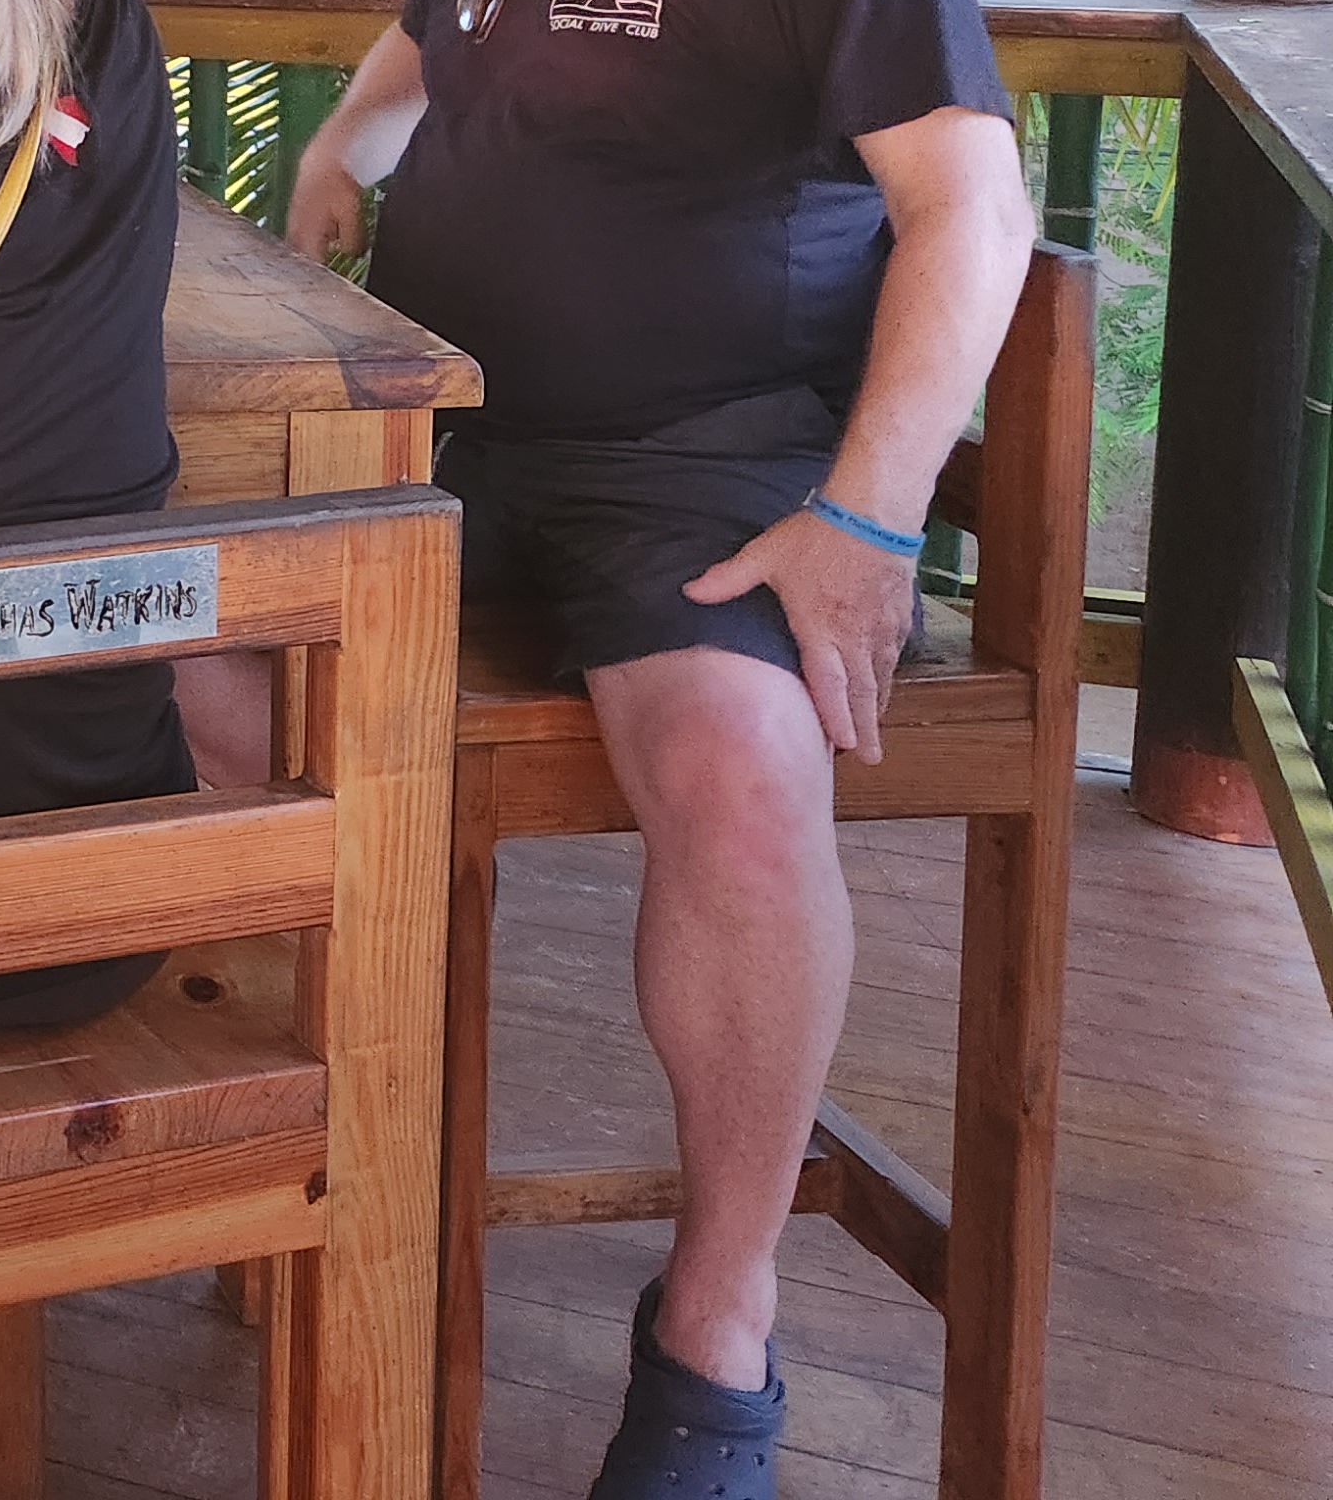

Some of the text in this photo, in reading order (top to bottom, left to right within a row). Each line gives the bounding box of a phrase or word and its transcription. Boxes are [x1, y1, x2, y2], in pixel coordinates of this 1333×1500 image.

[550, 19, 659, 39] SOCIAL DIVE CLUB
